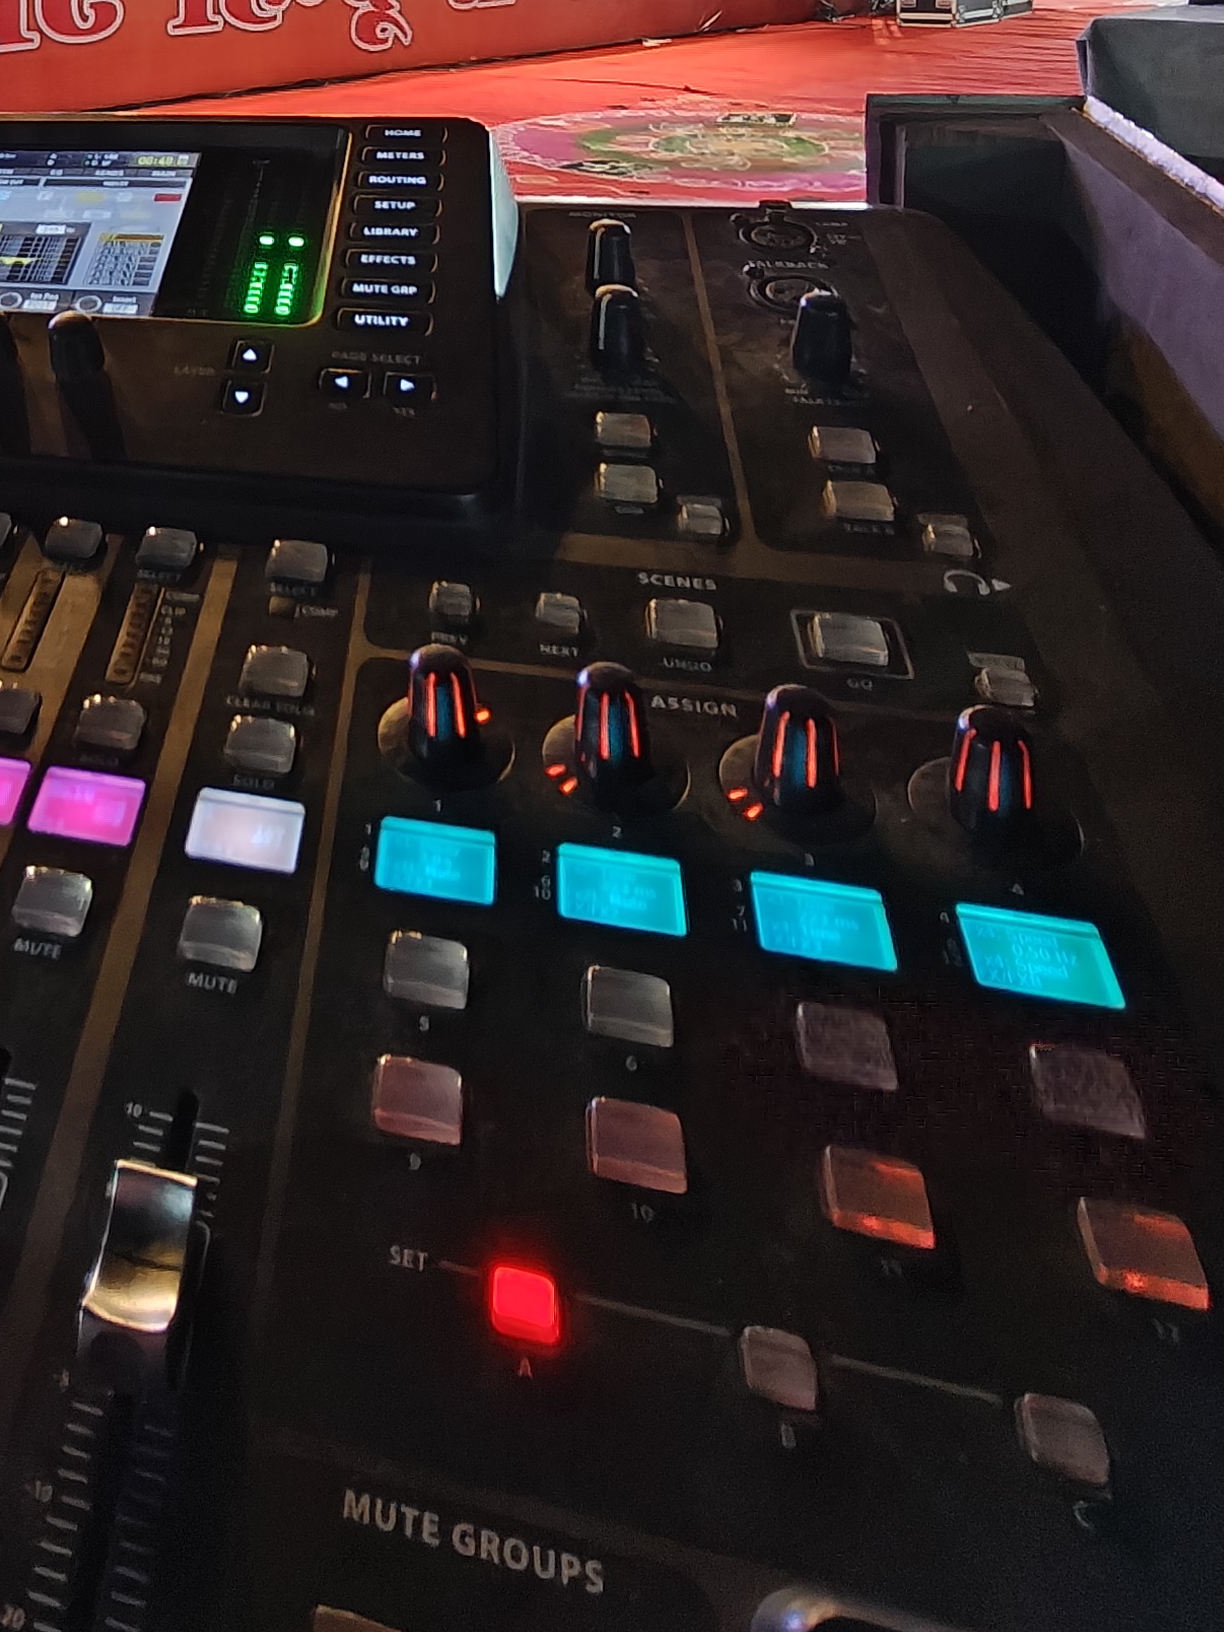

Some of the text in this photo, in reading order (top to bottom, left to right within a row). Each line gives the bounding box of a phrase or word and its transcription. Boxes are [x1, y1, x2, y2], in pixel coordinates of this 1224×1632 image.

[384, 129, 423, 138] HOME
[376, 151, 425, 160] METERS
[368, 175, 427, 185] ROUTING
[373, 200, 417, 210] SETUP
[362, 226, 419, 237] LIBRARY
[359, 253, 417, 265] EFFECTS
[351, 282, 389, 295] MUTE
[354, 313, 410, 328] UTILITY
[371, 352, 422, 365] SELECT
[637, 571, 718, 591] SCENES
[650, 693, 738, 718] ASSIGN
[13, 937, 63, 960] MUTE
[187, 971, 239, 994] MUTE
[125, 1101, 143, 1119] 10
[388, 1244, 429, 1272] SET
[342, 1488, 605, 1595] MUTE GROUPS
